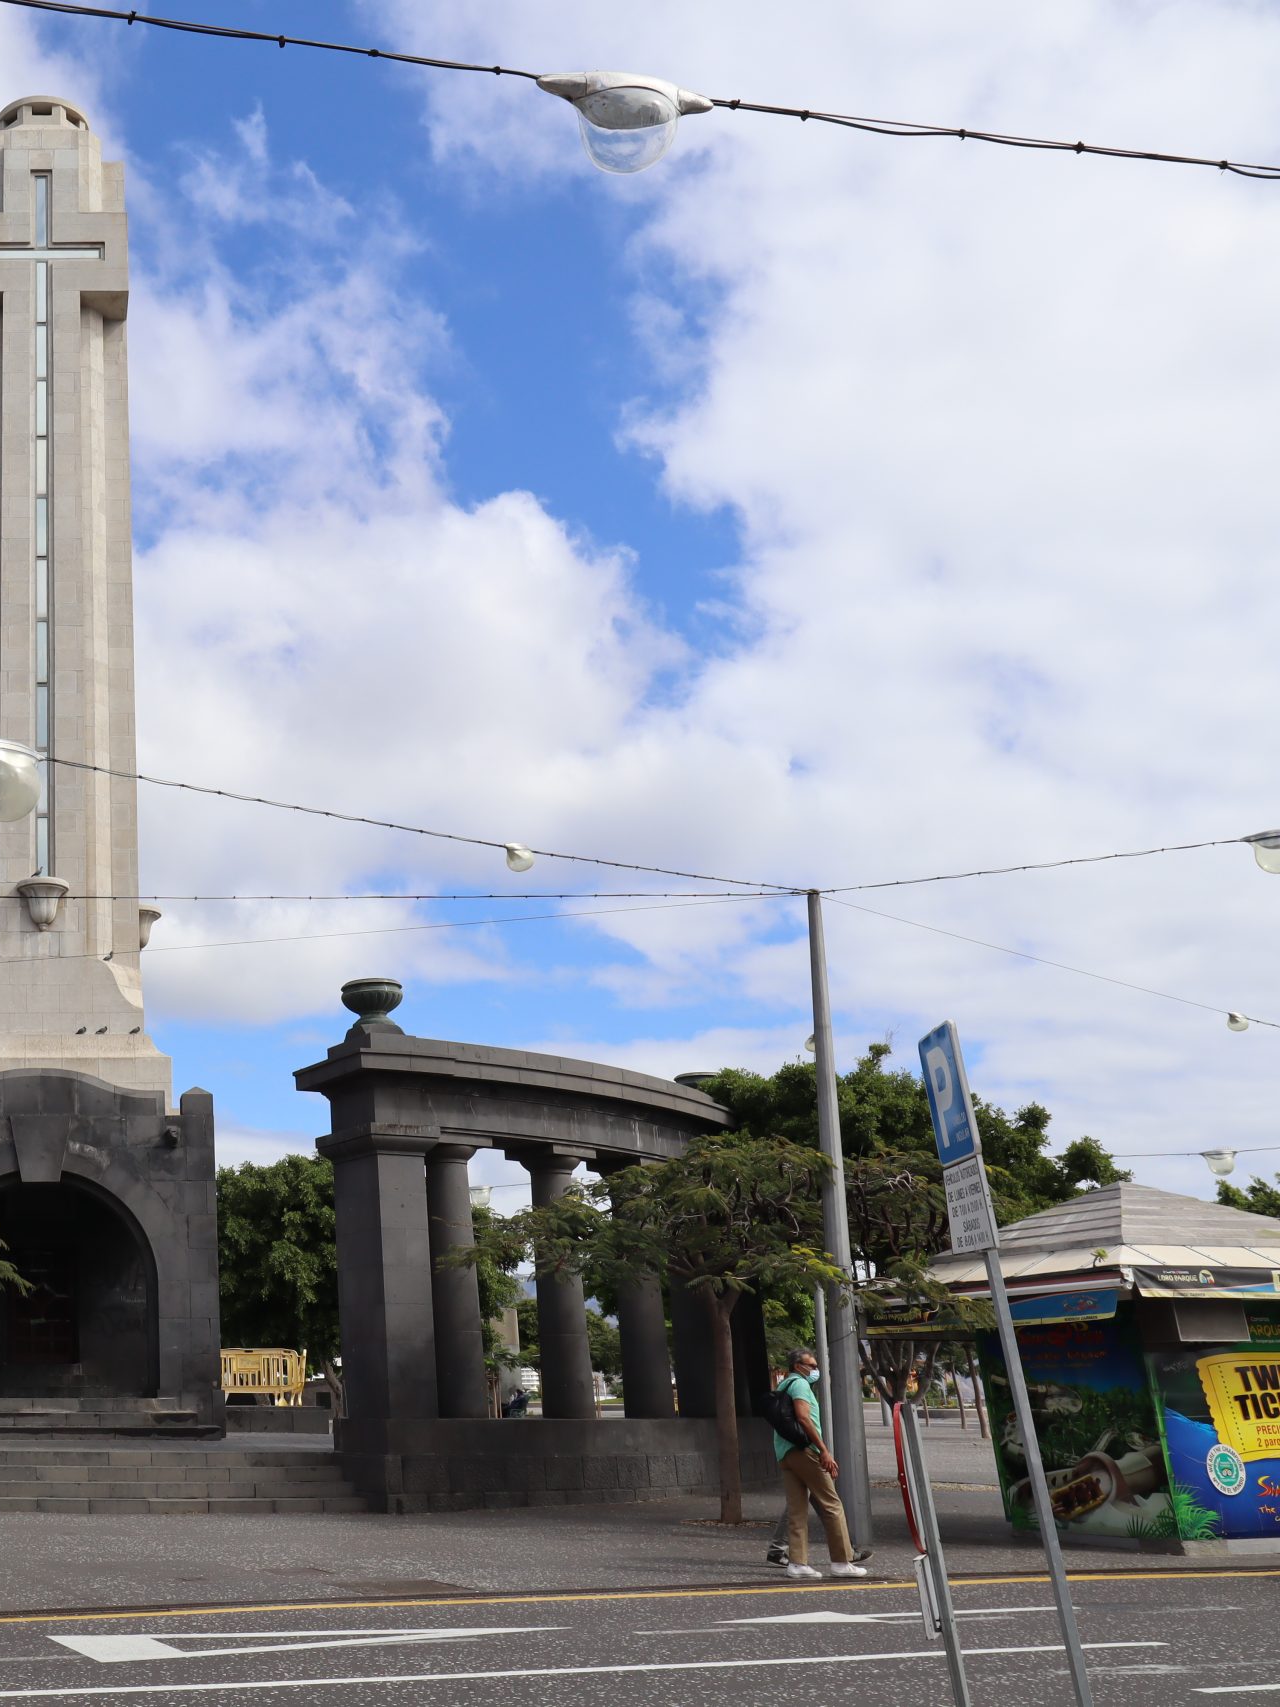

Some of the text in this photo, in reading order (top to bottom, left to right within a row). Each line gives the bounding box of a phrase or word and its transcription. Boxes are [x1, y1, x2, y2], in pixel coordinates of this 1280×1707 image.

[926, 1046, 953, 1148] P
[952, 1206, 959, 1218] DE
[957, 1236, 963, 1248] DE
[1157, 1273, 1198, 1282] LORO PARQUE
[1234, 1364, 1280, 1392] TW
[1234, 1392, 1280, 1421] TIC
[1256, 1424, 1280, 1435] PRECI
[1257, 1437, 1263, 1447] 2
